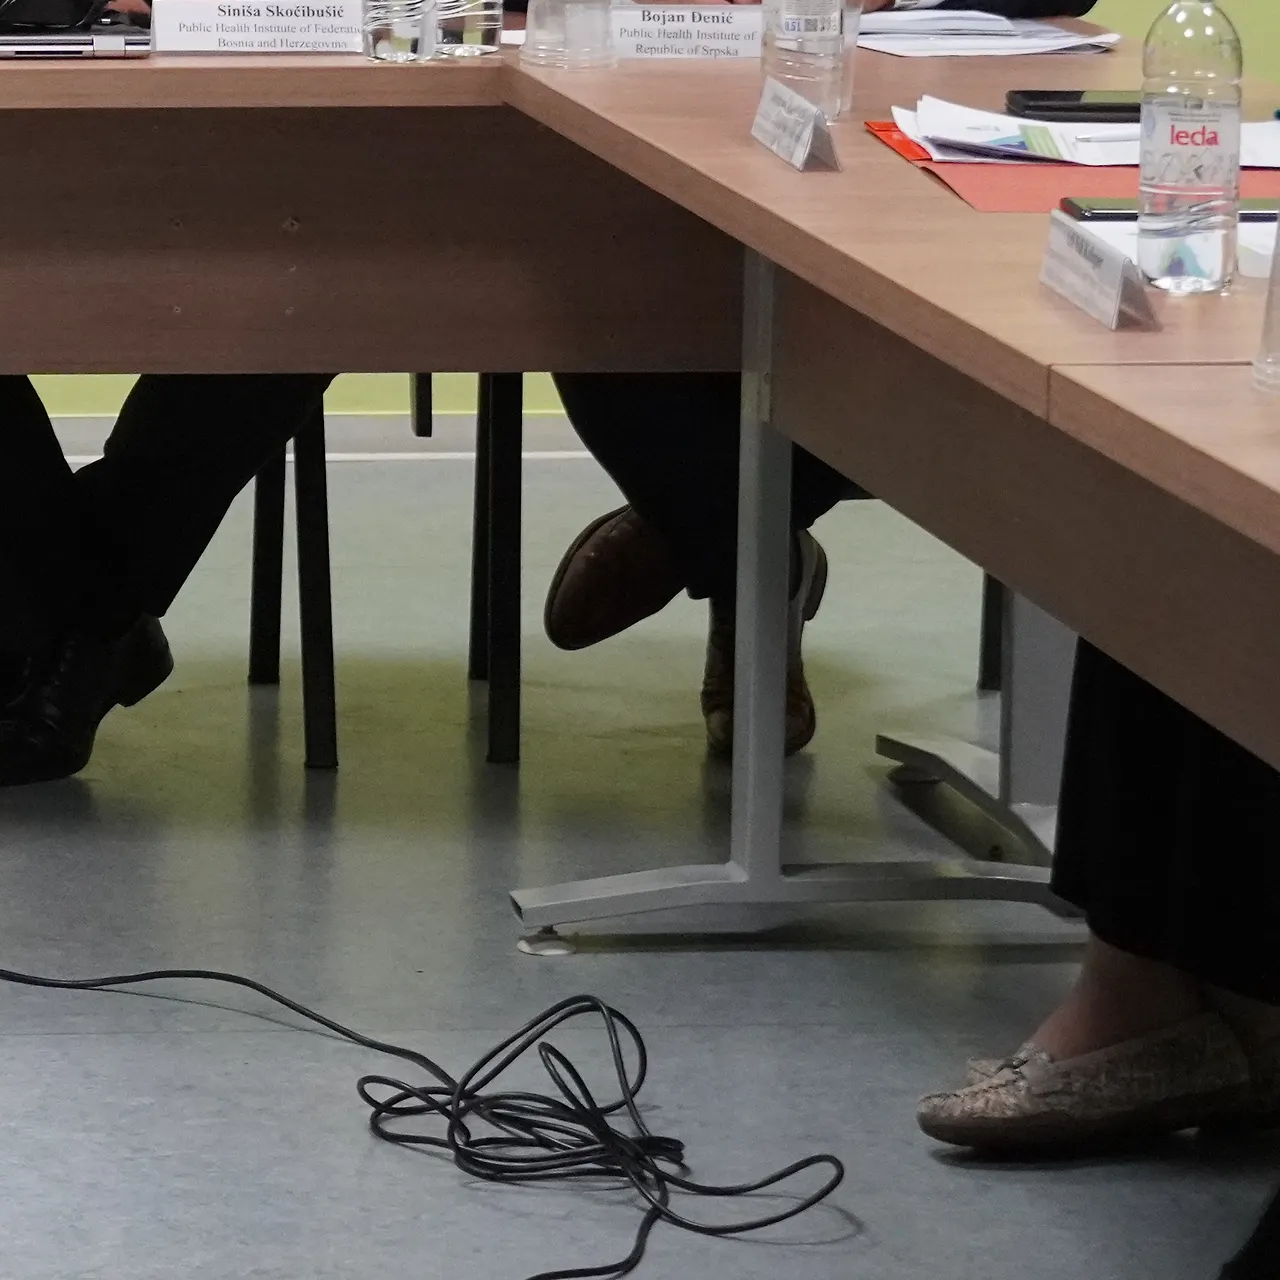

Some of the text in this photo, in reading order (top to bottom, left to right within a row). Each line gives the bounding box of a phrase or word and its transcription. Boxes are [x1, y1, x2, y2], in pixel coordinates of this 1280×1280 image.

[217, 4, 261, 17] Siniša
[642, 10, 733, 25] Bojan Đenić
[179, 23, 212, 33] Public
[216, 23, 250, 33] Health
[254, 23, 296, 33] Institute
[300, 23, 312, 33] of
[620, 28, 757, 41] Public Health Institute of
[218, 38, 254, 48] Bosnia
[257, 38, 276, 48] and
[636, 44, 739, 58] Republic of Srpska
[1169, 124, 1218, 146] leda
